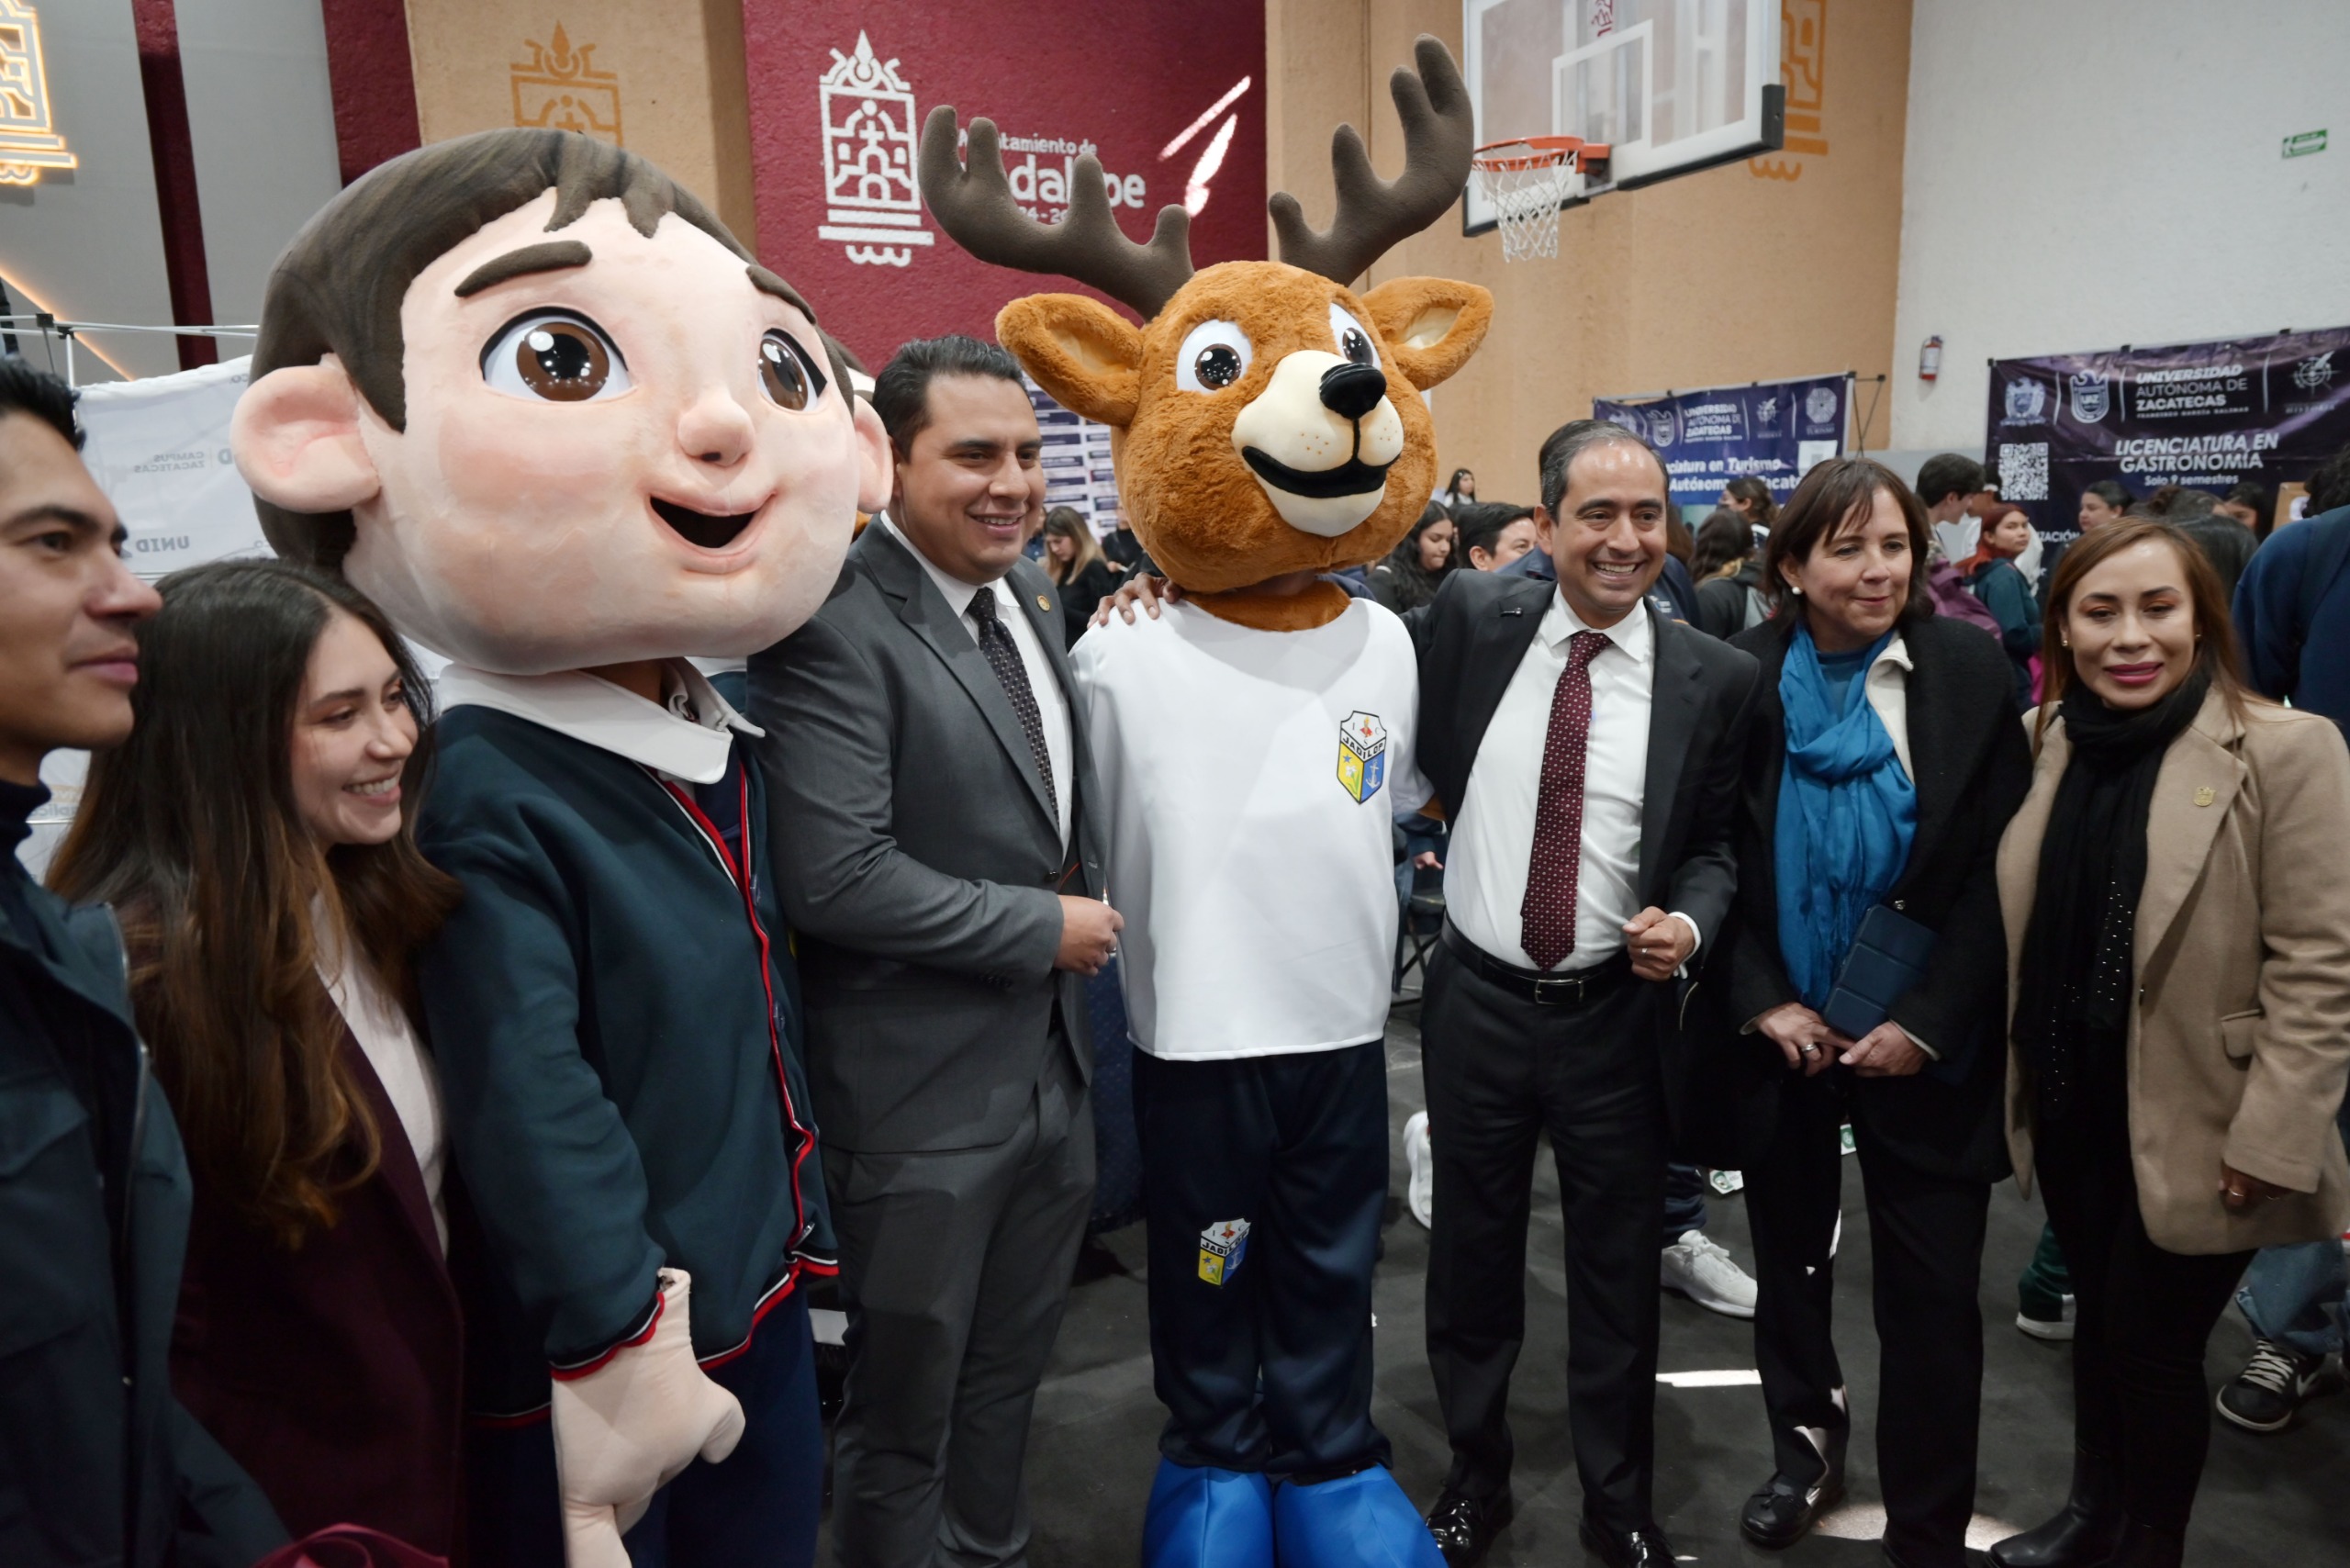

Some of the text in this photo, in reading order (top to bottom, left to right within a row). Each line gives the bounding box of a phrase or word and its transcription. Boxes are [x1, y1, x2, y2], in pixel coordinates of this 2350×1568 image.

[957, 128, 1098, 155] Atamiento de
[961, 153, 1147, 208] dalpe
[2135, 364, 2244, 384] UNIVERSIDAD
[2136, 377, 2249, 398] AUTÓNOMA DE
[2136, 394, 2226, 411] ZACATECAS
[2114, 432, 2279, 456] LICENCIATURA EN
[1665, 456, 1781, 475] ciatura en Turismo
[2120, 449, 2264, 473] GASTRONOMÍA
[2144, 473, 2239, 487] Solo 9 semestres
